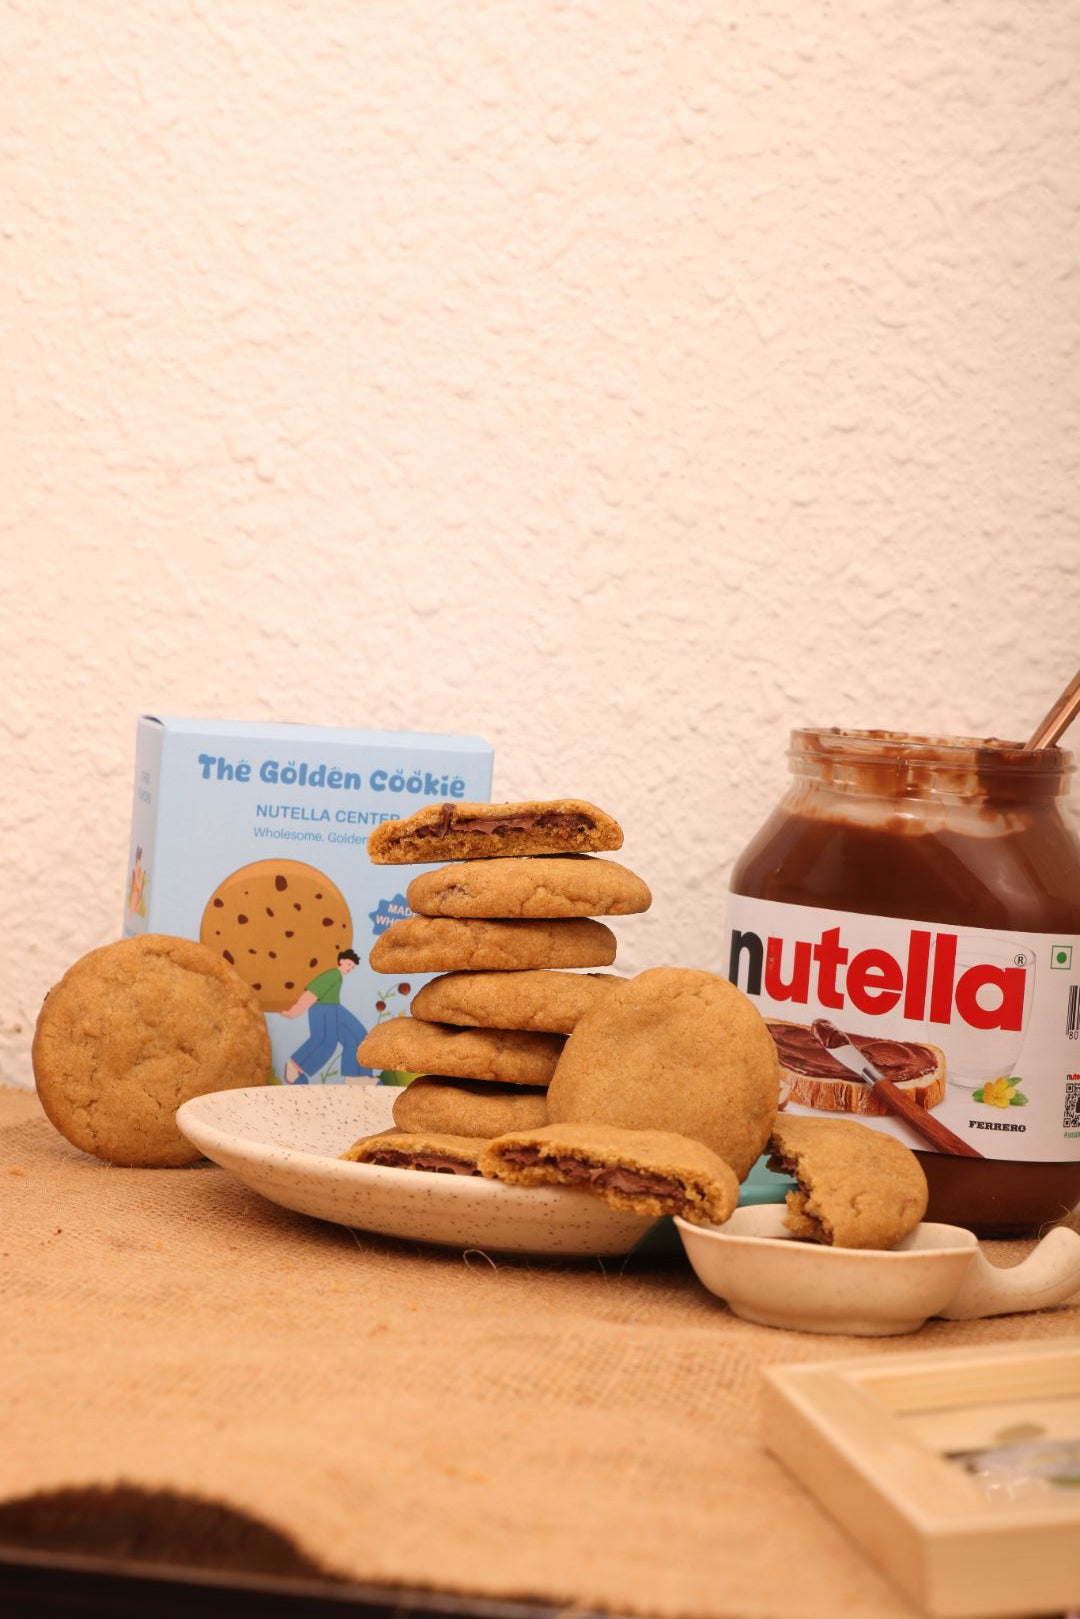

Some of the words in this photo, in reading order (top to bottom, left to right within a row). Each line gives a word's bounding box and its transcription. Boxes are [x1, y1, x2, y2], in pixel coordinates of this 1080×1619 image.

[198, 753, 252, 783] The
[256, 804, 331, 823] NUTELLA
[253, 827, 323, 843] Wholesome.
[728, 926, 1027, 1032] nutella
[968, 1120, 1027, 1134] FERRERO
